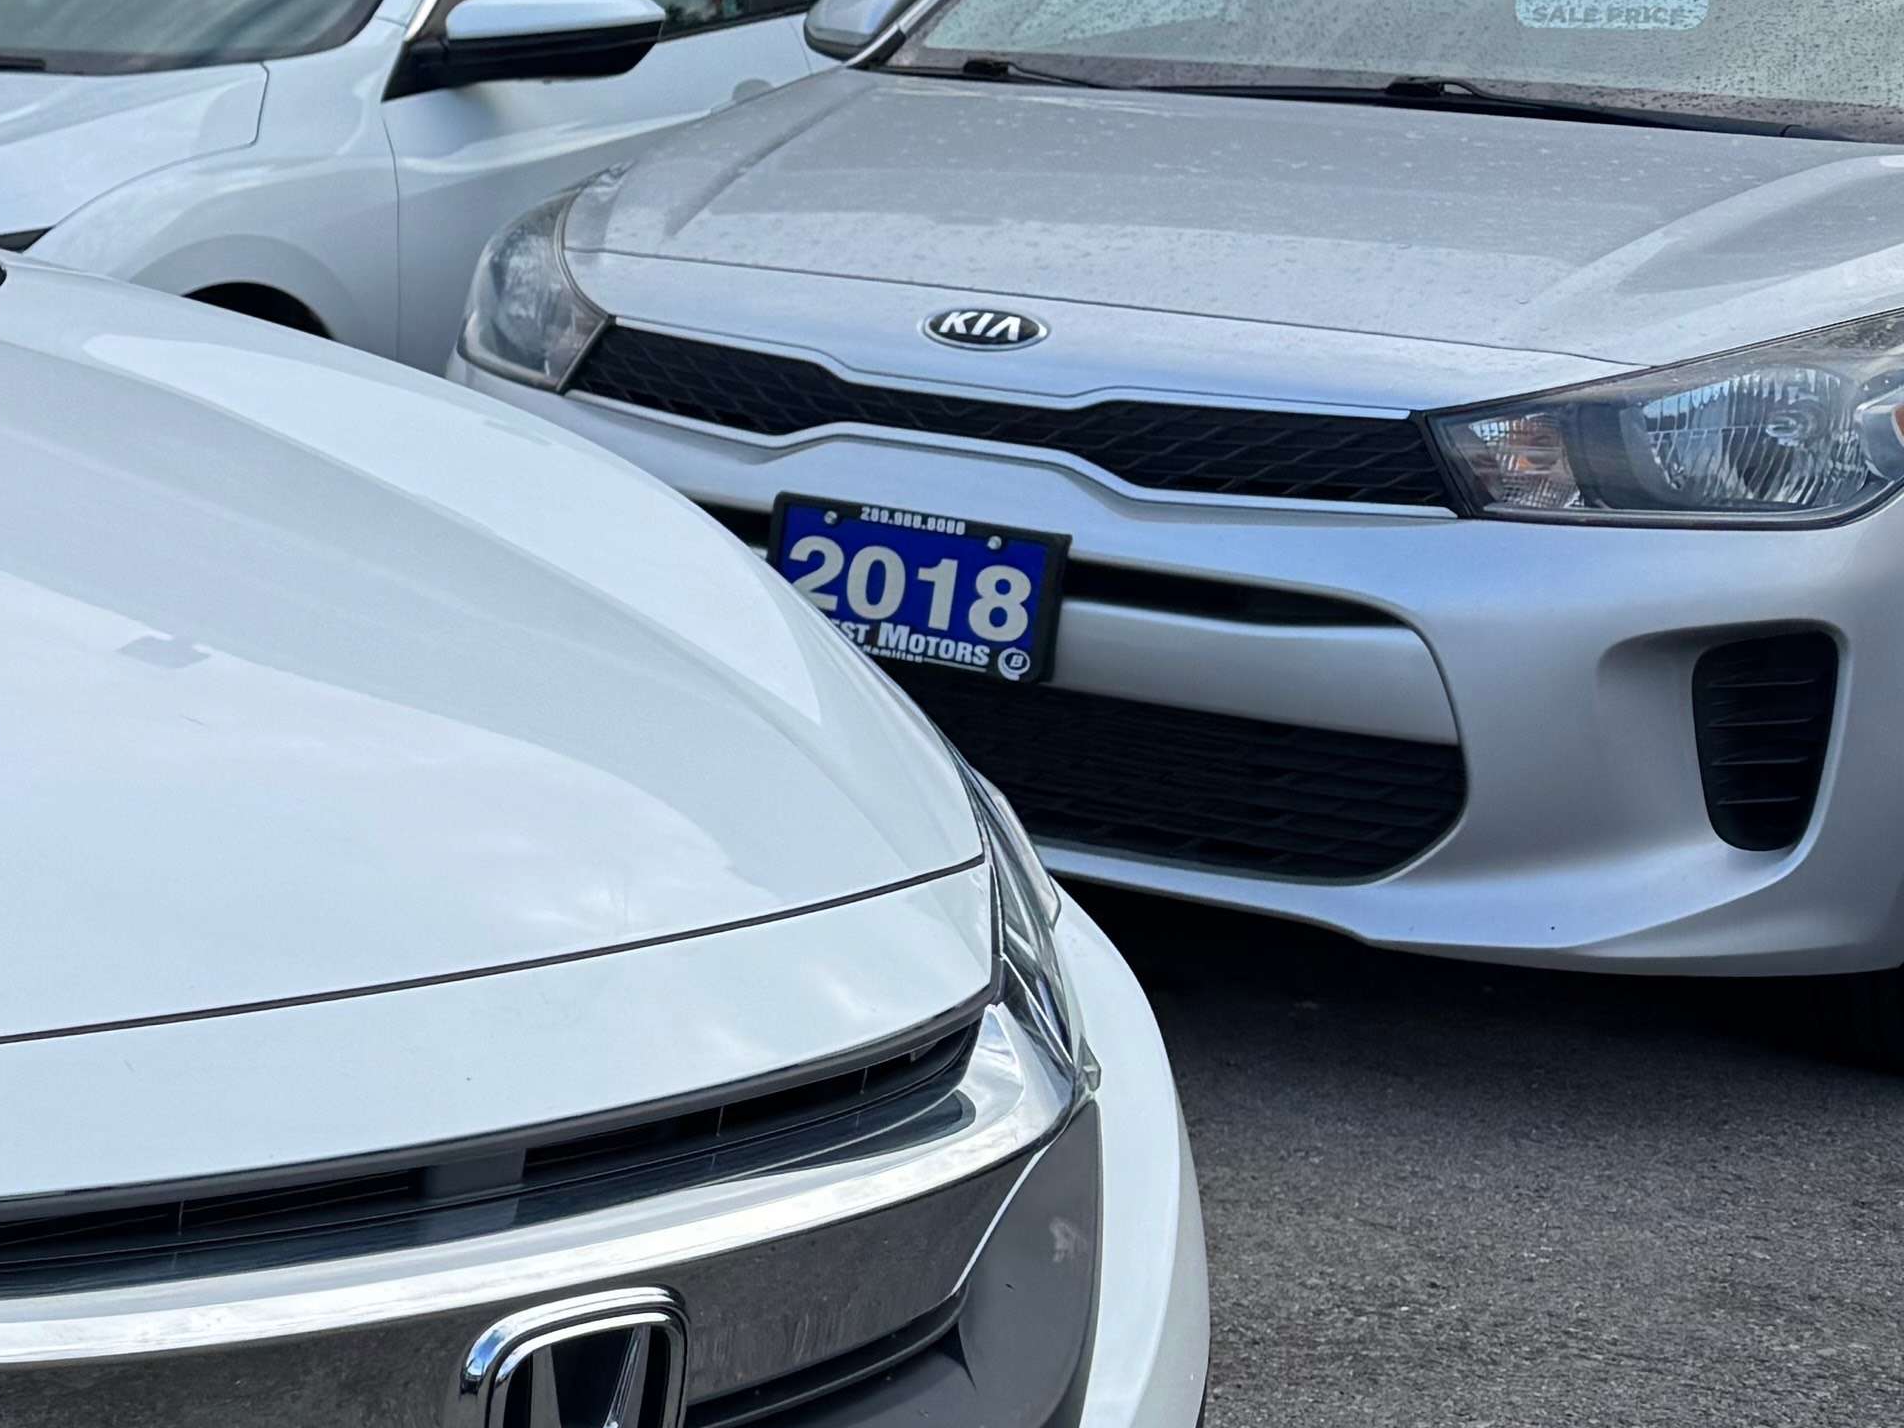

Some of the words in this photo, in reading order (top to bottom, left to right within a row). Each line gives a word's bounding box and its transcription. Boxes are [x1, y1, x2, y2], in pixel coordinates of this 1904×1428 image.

[1531, 6, 1600, 23] SALE
[1605, 5, 1686, 22] PRICE
[939, 311, 1020, 341] KIA
[789, 536, 1031, 642] 2018
